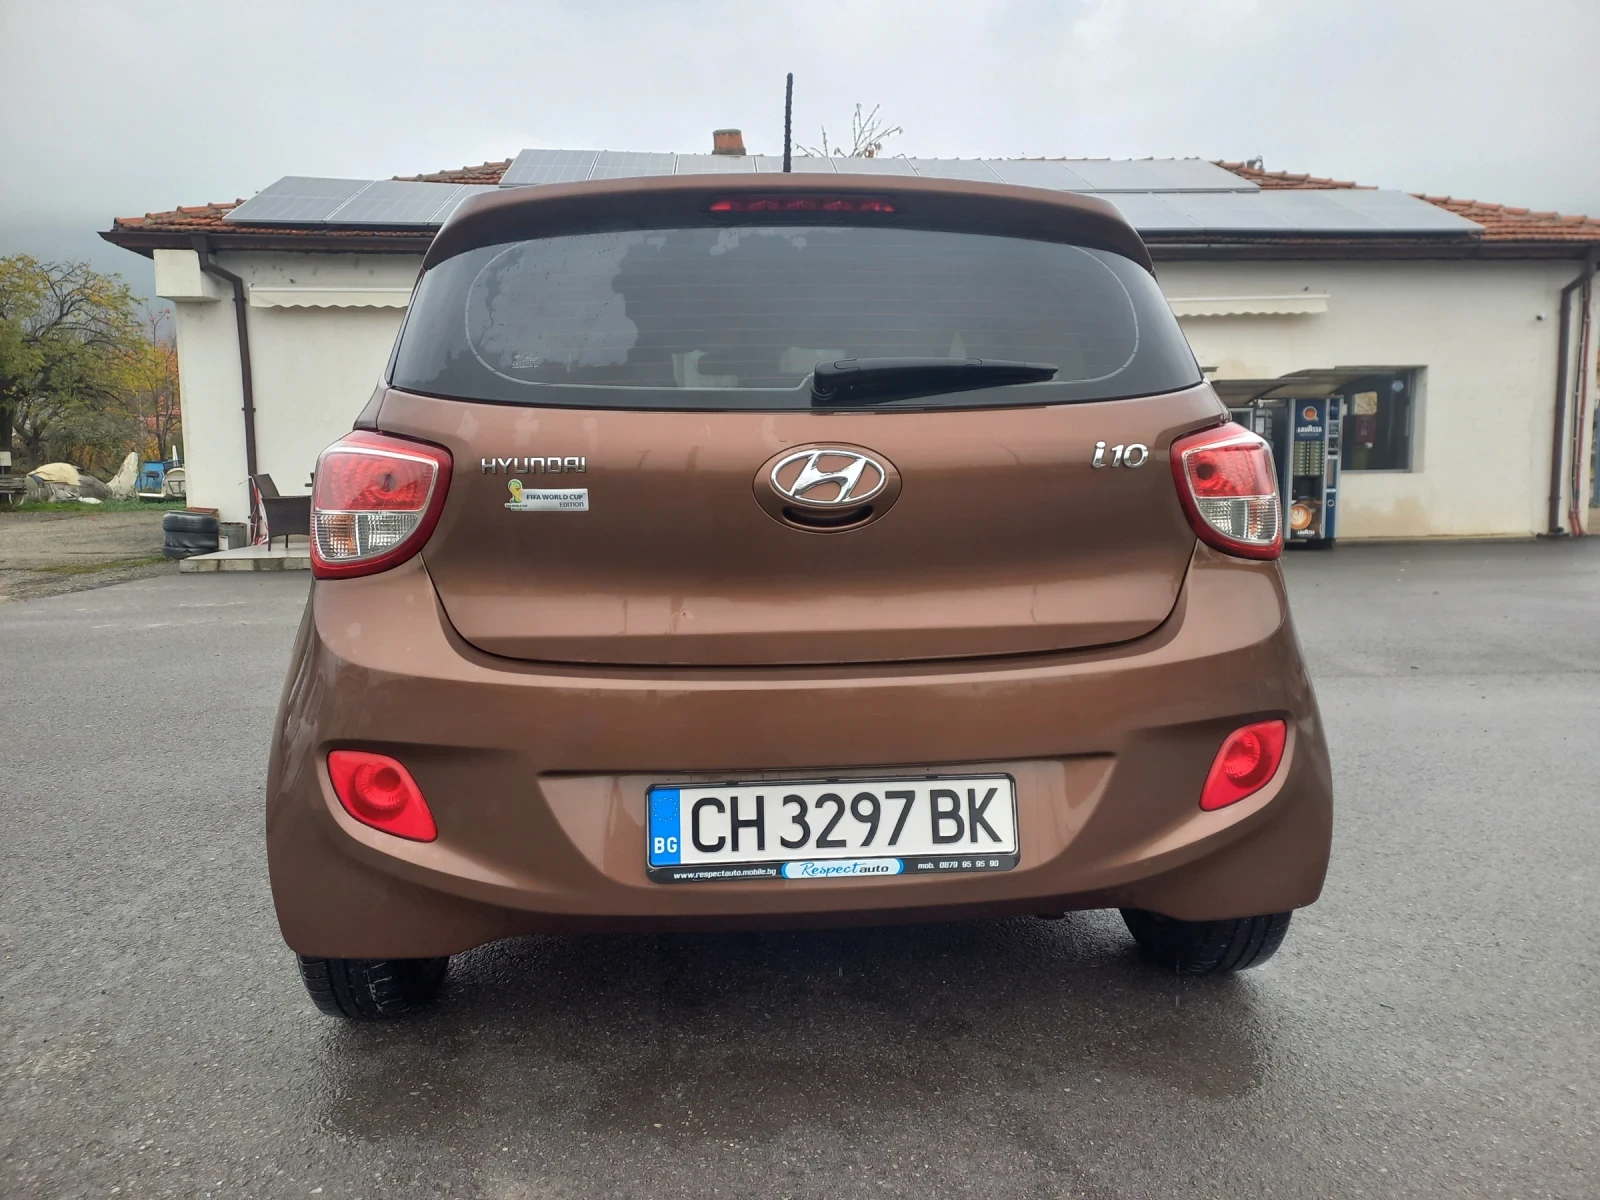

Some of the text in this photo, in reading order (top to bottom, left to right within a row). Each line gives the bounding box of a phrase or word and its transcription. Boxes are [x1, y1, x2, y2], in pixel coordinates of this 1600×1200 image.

[1092, 441, 1149, 469] i10
[481, 456, 586, 474] HYUNDAI
[691, 787, 1003, 853] CH 3297 BK
[654, 837, 678, 854] BG
[917, 862, 935, 870] mob.
[939, 861, 958, 869] 0879
[962, 860, 972, 868] 95
[975, 860, 986, 868] 95
[673, 868, 777, 880] www.respectauto.mobile.bg
